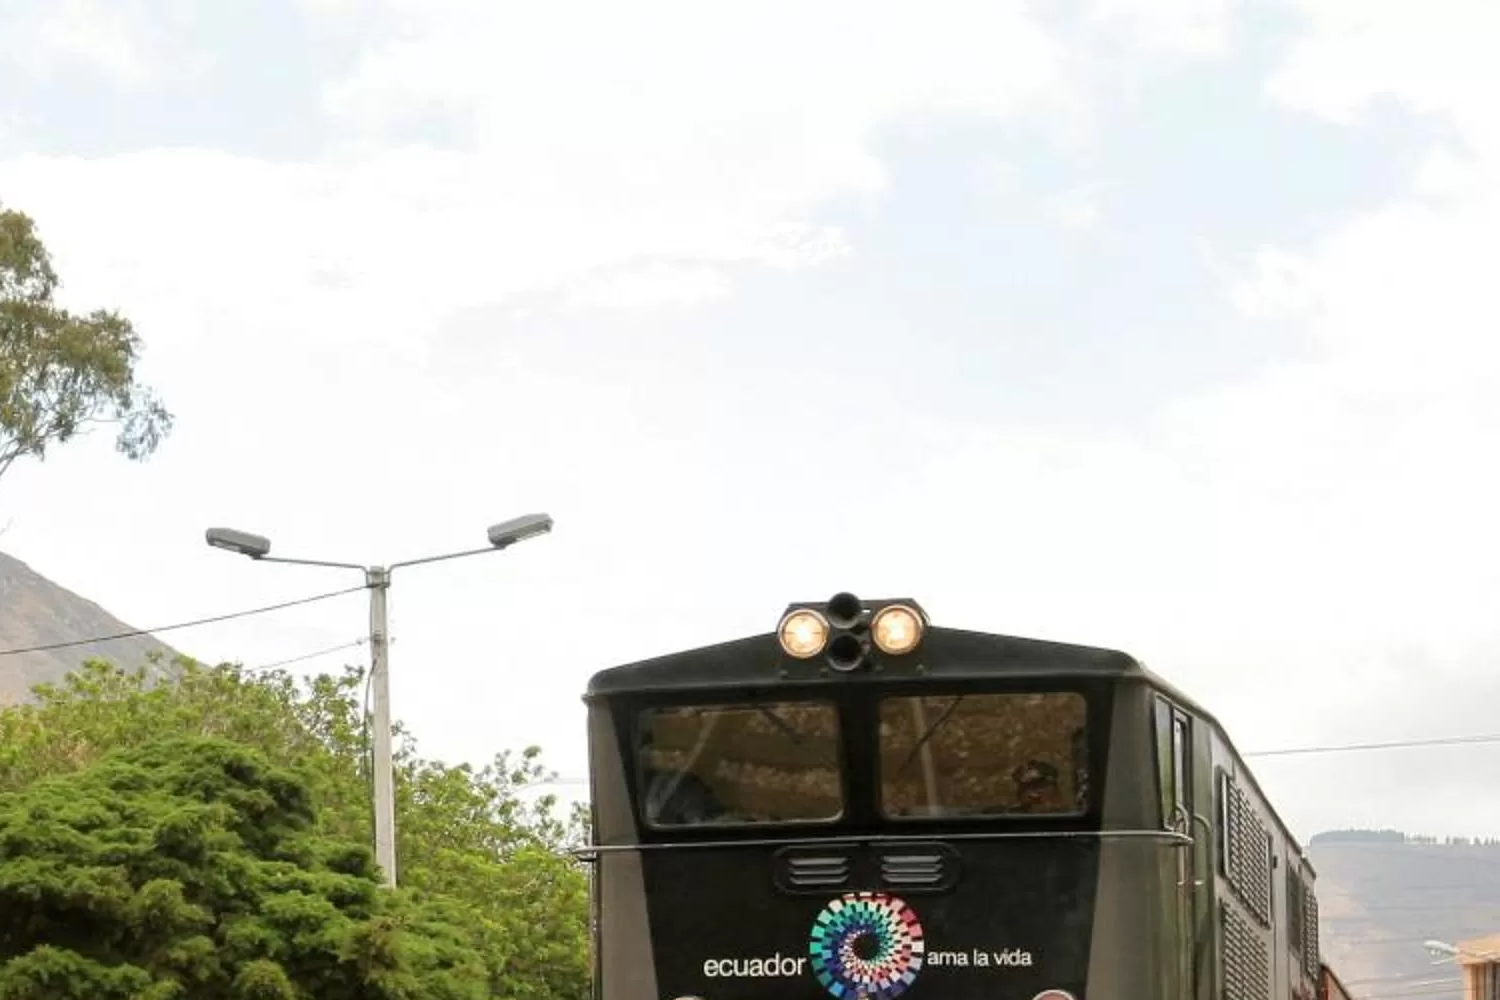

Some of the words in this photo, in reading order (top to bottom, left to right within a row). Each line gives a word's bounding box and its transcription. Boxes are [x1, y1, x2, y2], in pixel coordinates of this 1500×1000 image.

[703, 952, 807, 977] ecuador
[927, 951, 969, 967] ama
[973, 948, 990, 967] la
[993, 948, 1033, 967] vida
